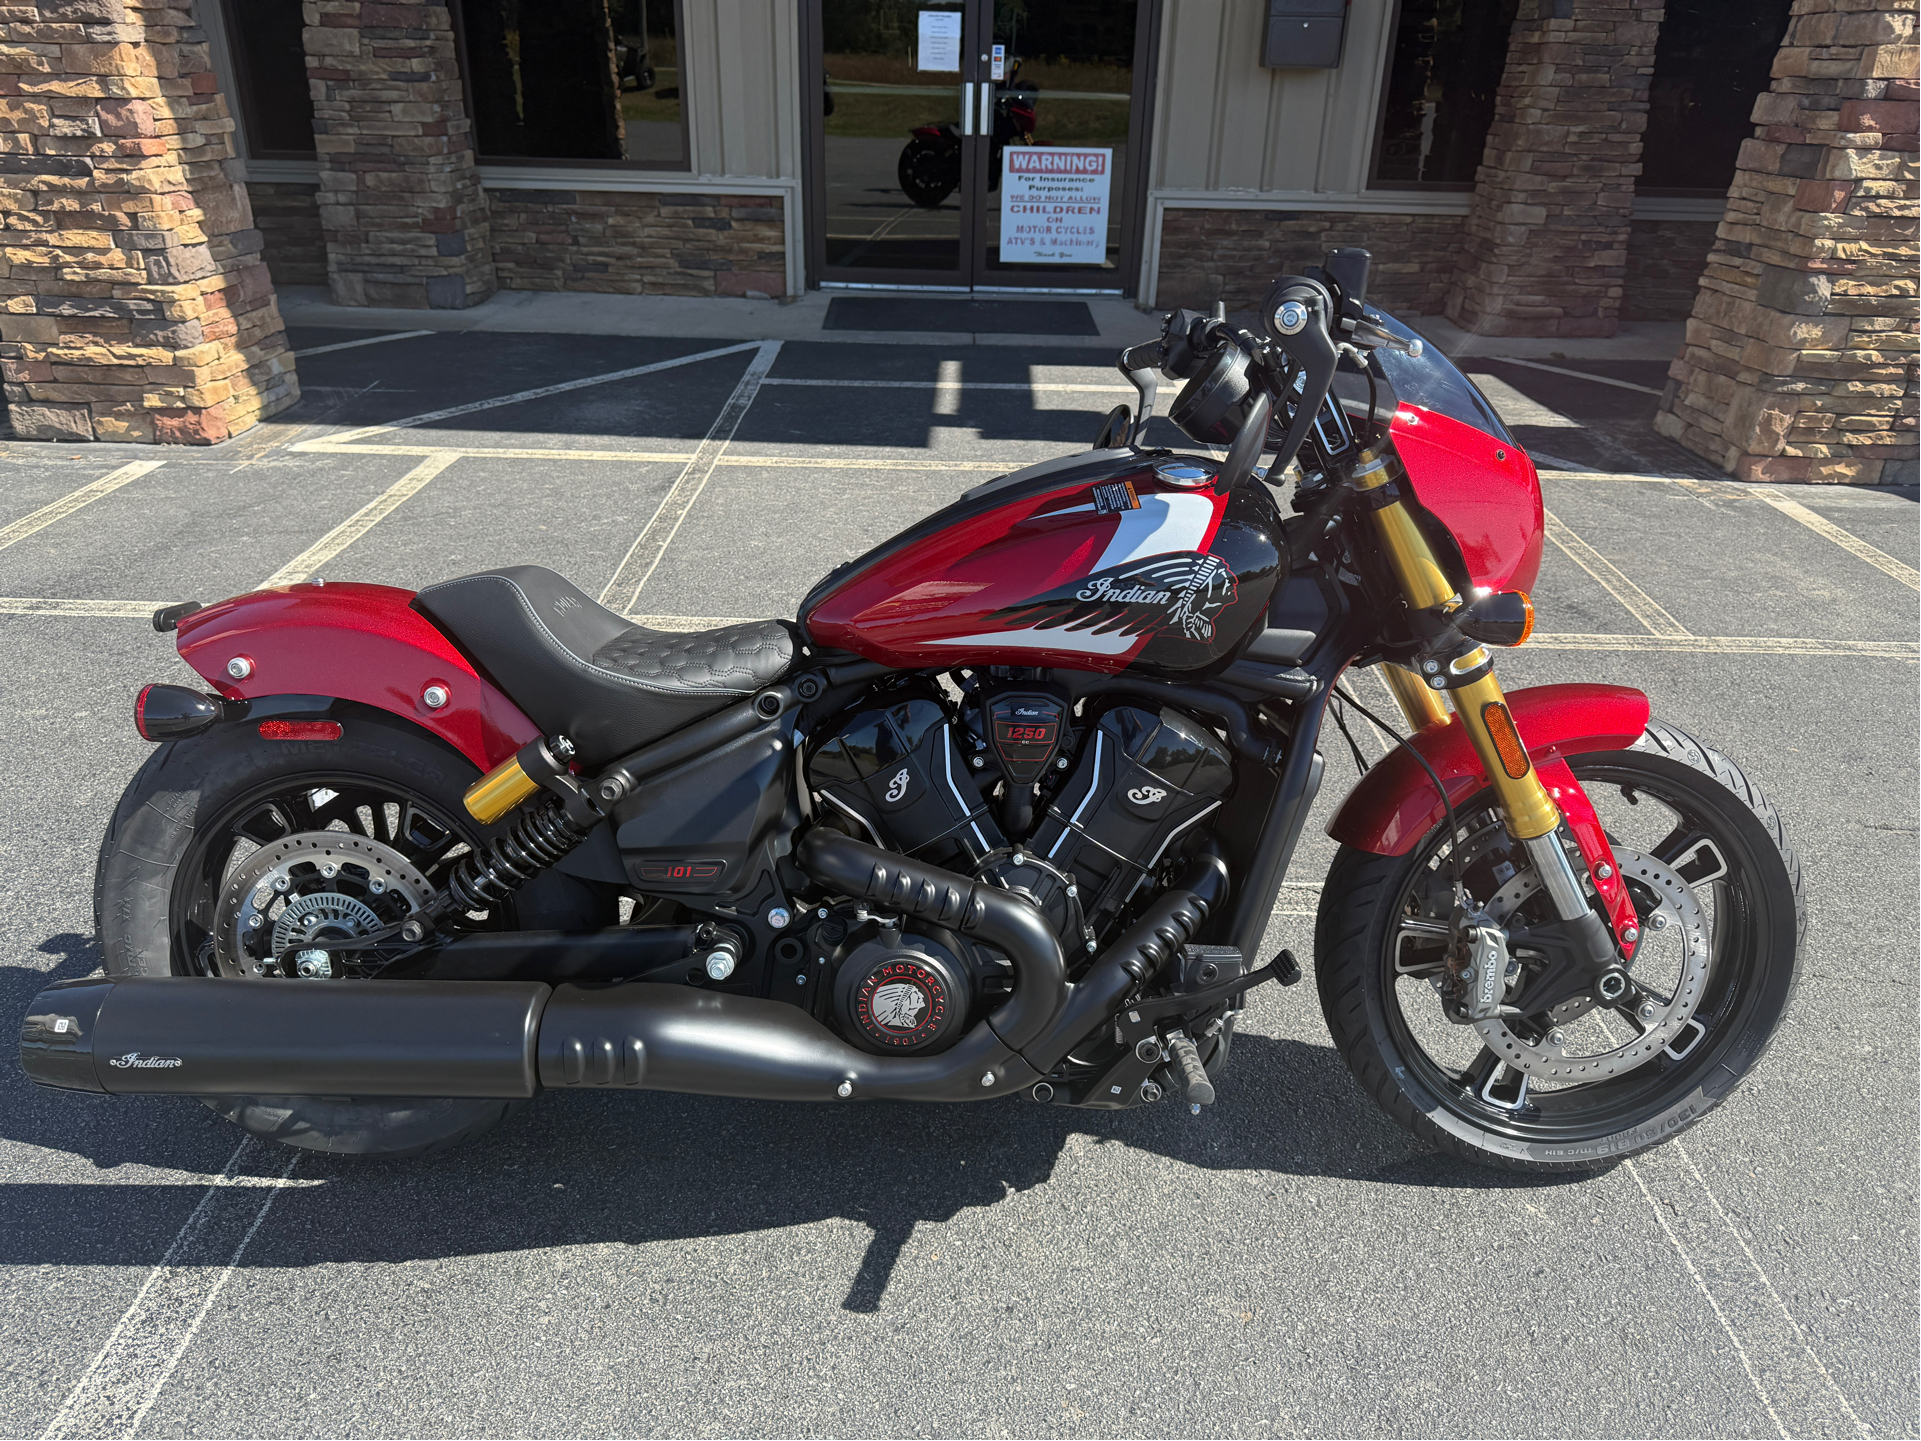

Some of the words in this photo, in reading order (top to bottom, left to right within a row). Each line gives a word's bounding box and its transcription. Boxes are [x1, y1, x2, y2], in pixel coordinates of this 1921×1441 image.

[1012, 153, 1103, 171] WARNING!
[1039, 175, 1096, 183] Insurance
[1028, 185, 1084, 193] Purposes:
[1010, 204, 1102, 215] CHILDREN
[1046, 216, 1063, 224] ON
[1016, 225, 1053, 235] MOTOR
[1055, 226, 1095, 235] CYCLES
[1050, 238, 1100, 249] Machinery
[1075, 577, 1172, 605] Indian
[1015, 707, 1039, 716] Indian
[1007, 727, 1047, 739] 1250
[281, 740, 446, 788] METZELER
[666, 866, 693, 878] 101
[1480, 950, 1498, 1003] brembo
[858, 975, 879, 1030] INDIAN
[882, 964, 945, 1031] MOTORCYCLE
[116, 1051, 176, 1069] Indian
